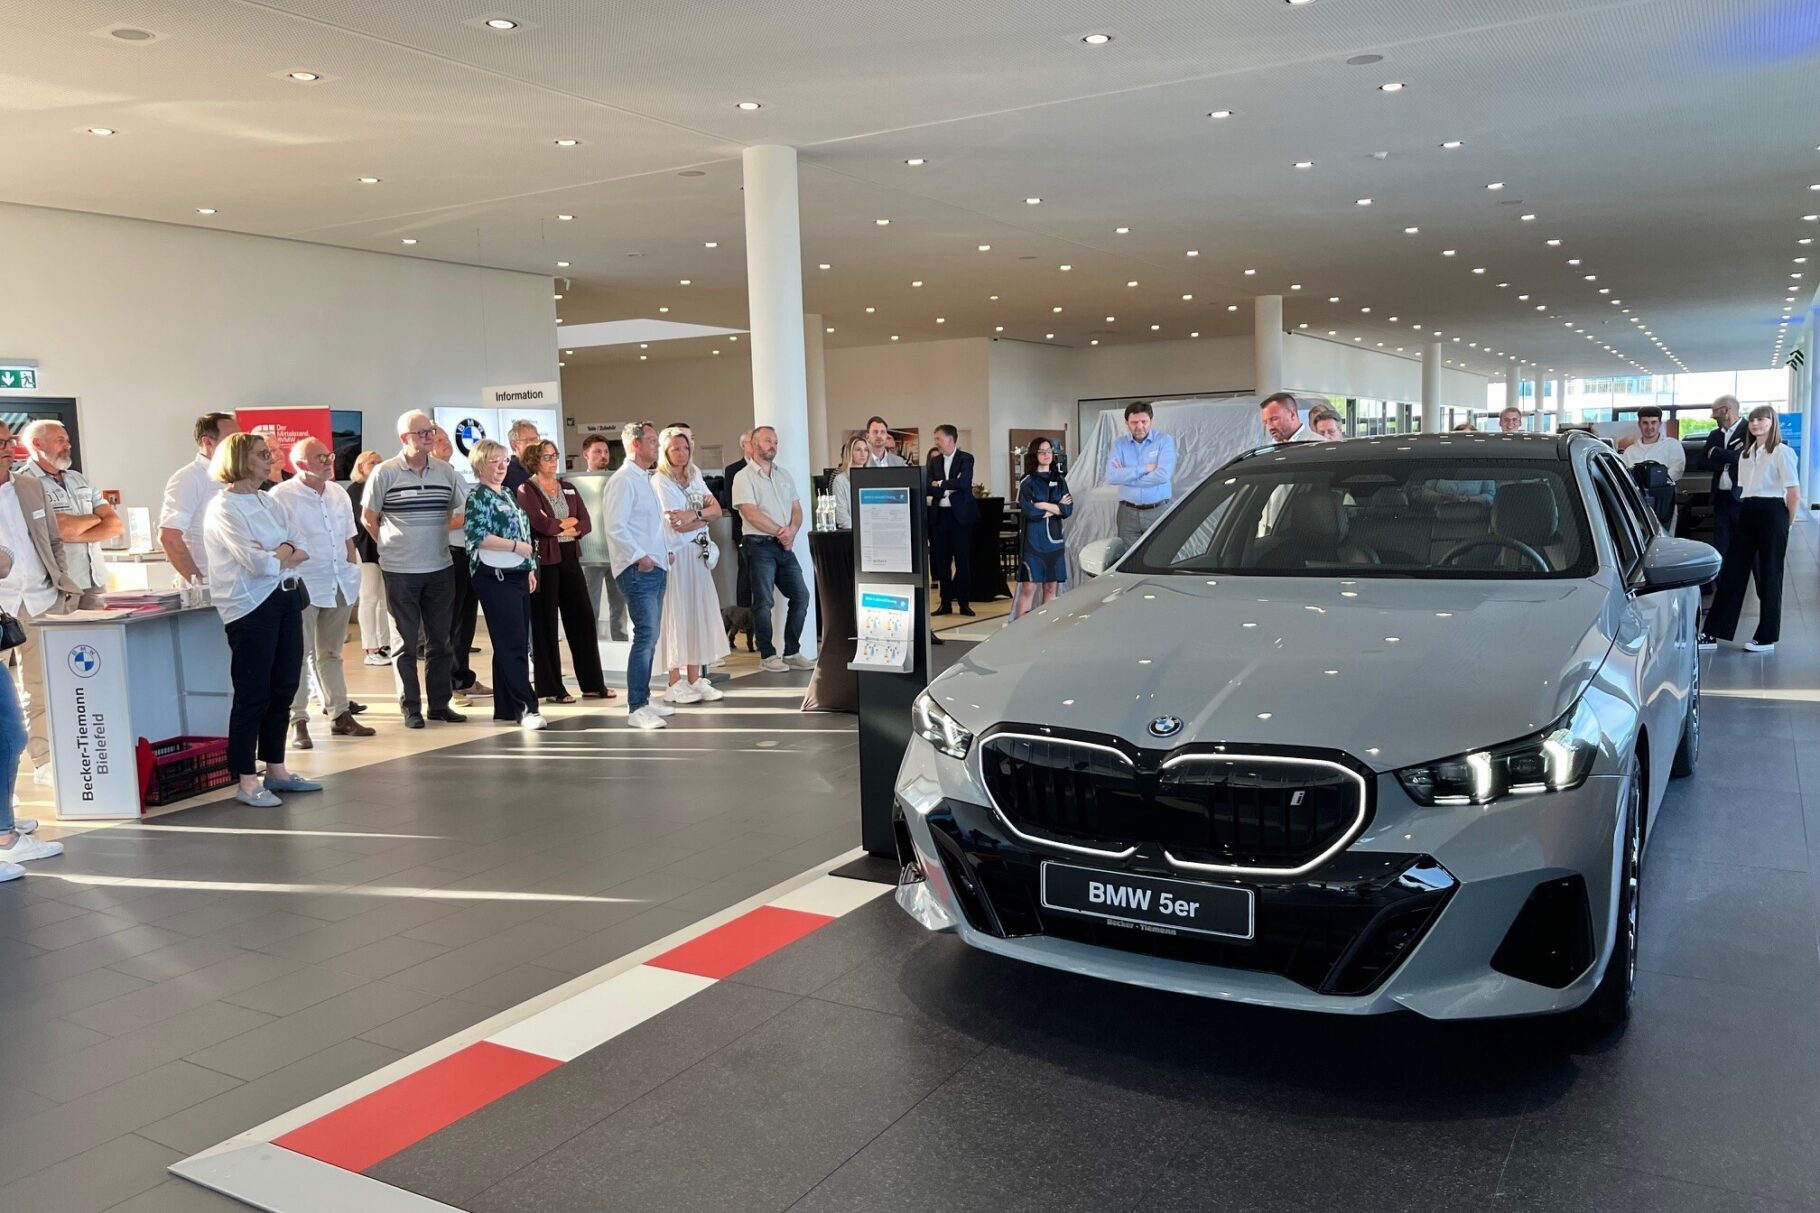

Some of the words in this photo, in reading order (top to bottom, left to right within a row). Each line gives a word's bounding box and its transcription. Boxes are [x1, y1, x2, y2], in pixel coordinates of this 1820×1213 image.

[496, 390, 543, 402] Information
[75, 687, 94, 801] Becker-Tiemann
[92, 713, 109, 775] Bielefeld
[1088, 881, 1152, 911] BMW
[1159, 892, 1200, 918] 5er
[1106, 919, 1134, 929] Becker
[1140, 923, 1177, 936] Tiemann
